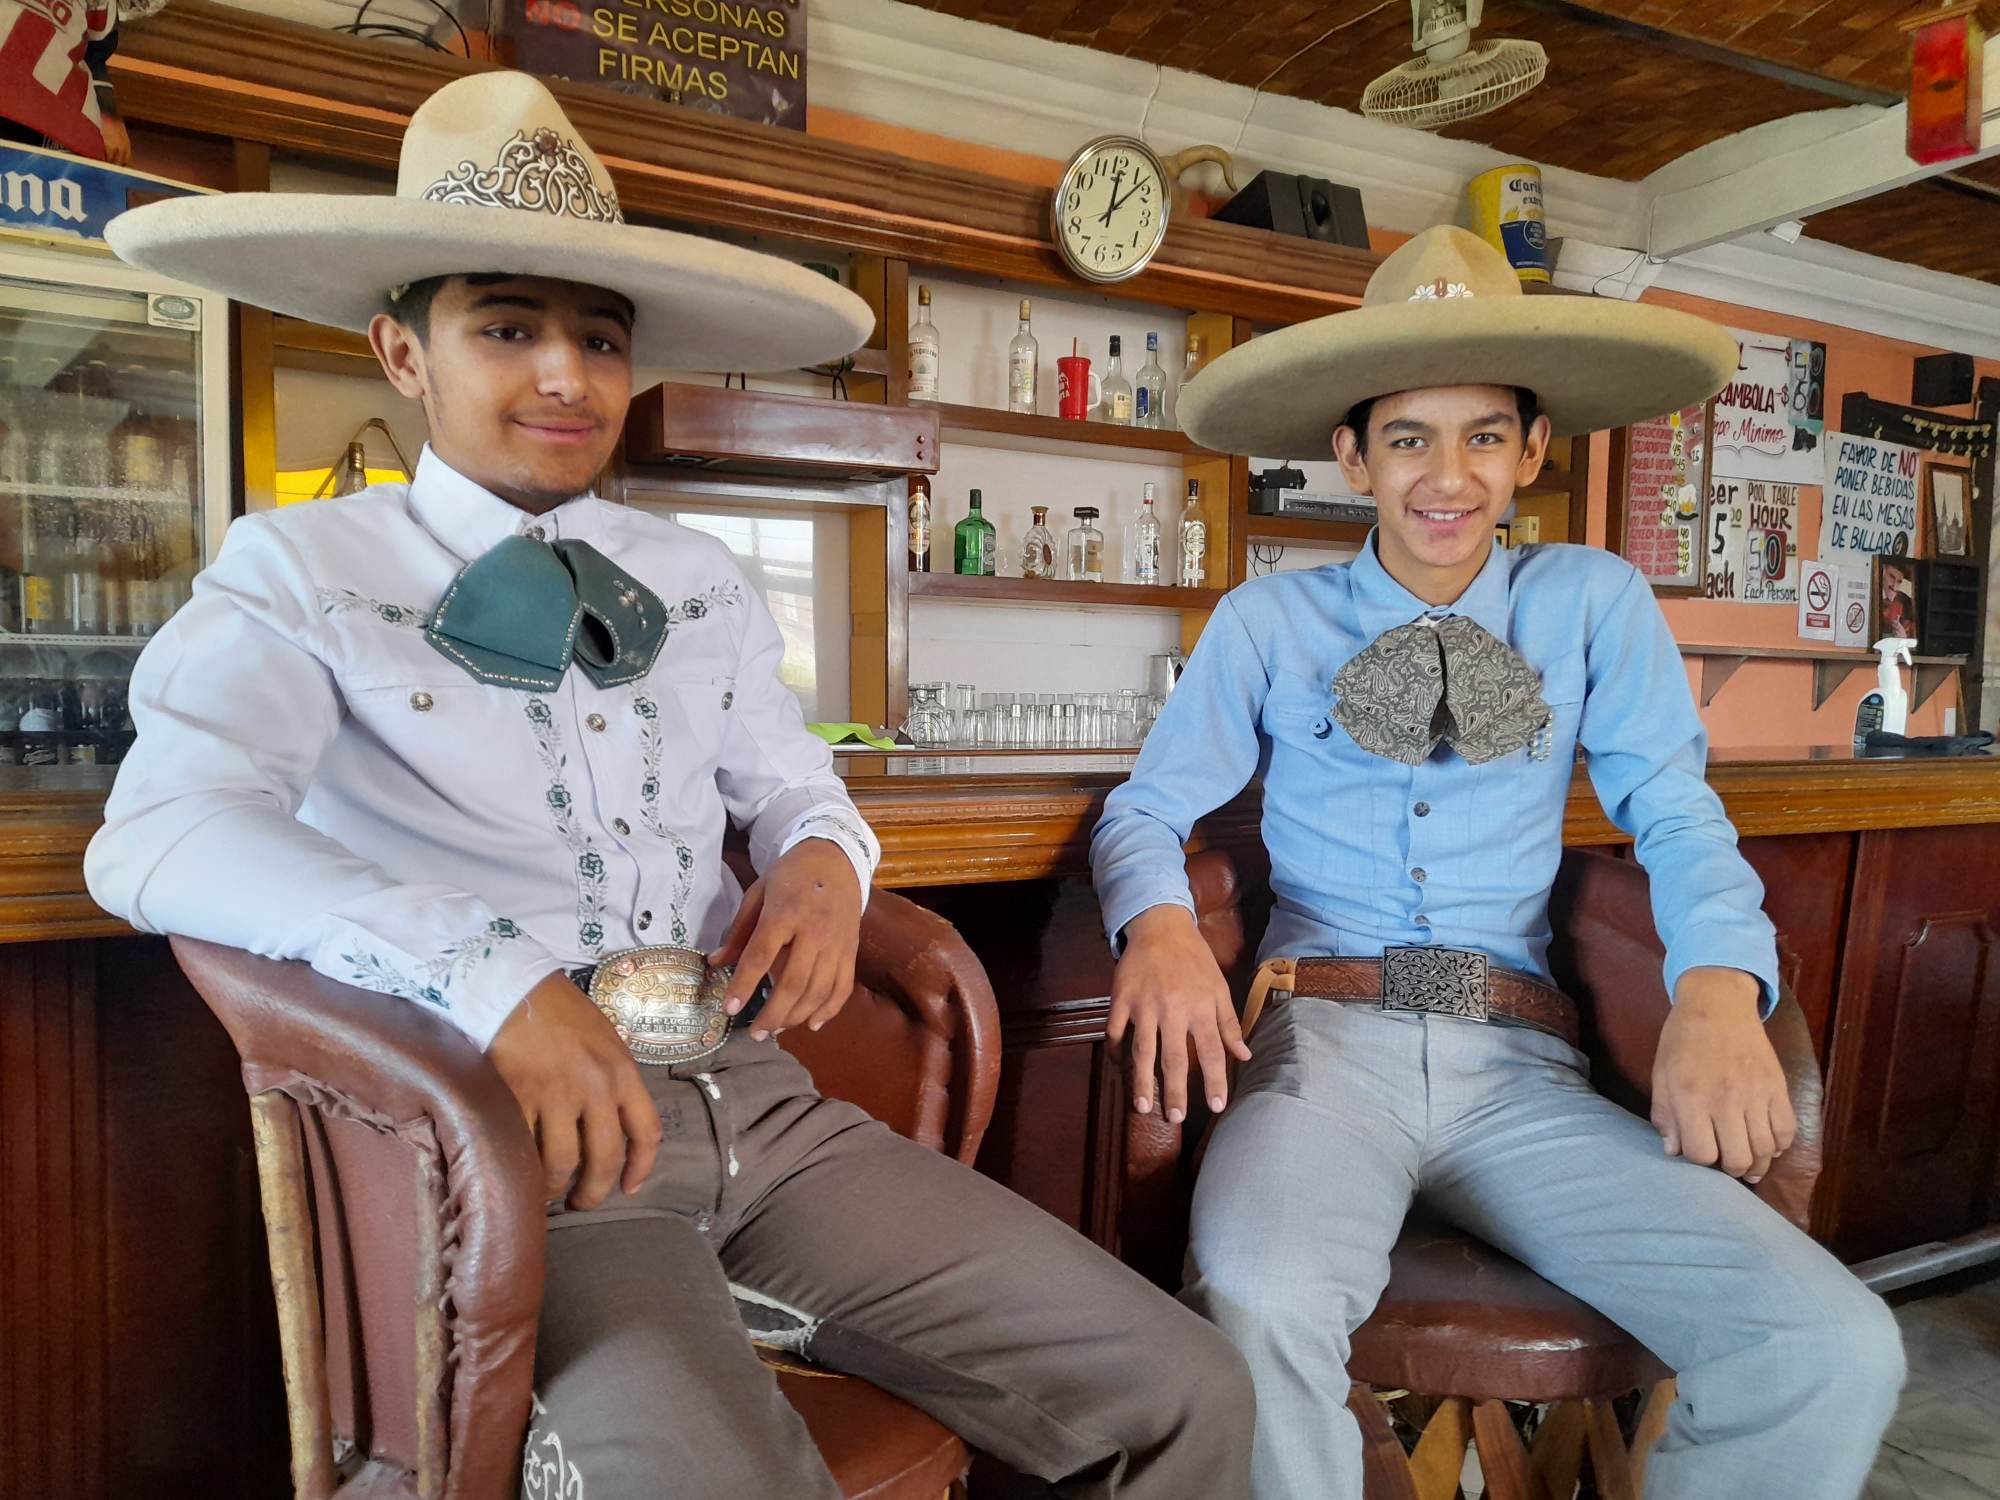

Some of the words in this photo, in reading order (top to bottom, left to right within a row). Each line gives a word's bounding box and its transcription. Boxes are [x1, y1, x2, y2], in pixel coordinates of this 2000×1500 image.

[592, 7, 639, 43] SE
[647, 21, 800, 80] ACEPTAN
[598, 48, 729, 100] FIRMAS
[1094, 157, 1108, 177] 11
[1133, 166, 1140, 185] 1
[1075, 172, 1094, 192] 10
[0, 170, 88, 223] na
[1068, 192, 1081, 212] 9
[1140, 183, 1151, 204] 2
[1068, 215, 1082, 235] 8
[1139, 208, 1151, 228] 3
[1080, 235, 1092, 255] 7
[1094, 243, 1107, 264] 6
[1111, 242, 1124, 262] 5
[1838, 441, 1877, 470] FAVOR
[1880, 450, 1898, 474] DE
[1898, 448, 1919, 479] NO
[1834, 466, 1868, 492] PONER
[1871, 474, 1915, 501] BEBIDAS
[1747, 482, 1768, 503] POOL
[1771, 484, 1798, 507] TABLE
[1750, 502, 1793, 531] HOUR
[1832, 494, 1850, 517] EN
[1851, 498, 1873, 522] LAS
[1876, 503, 1915, 531] MESAS
[1831, 520, 1848, 548] DE
[1849, 526, 1892, 555] BILLAR
